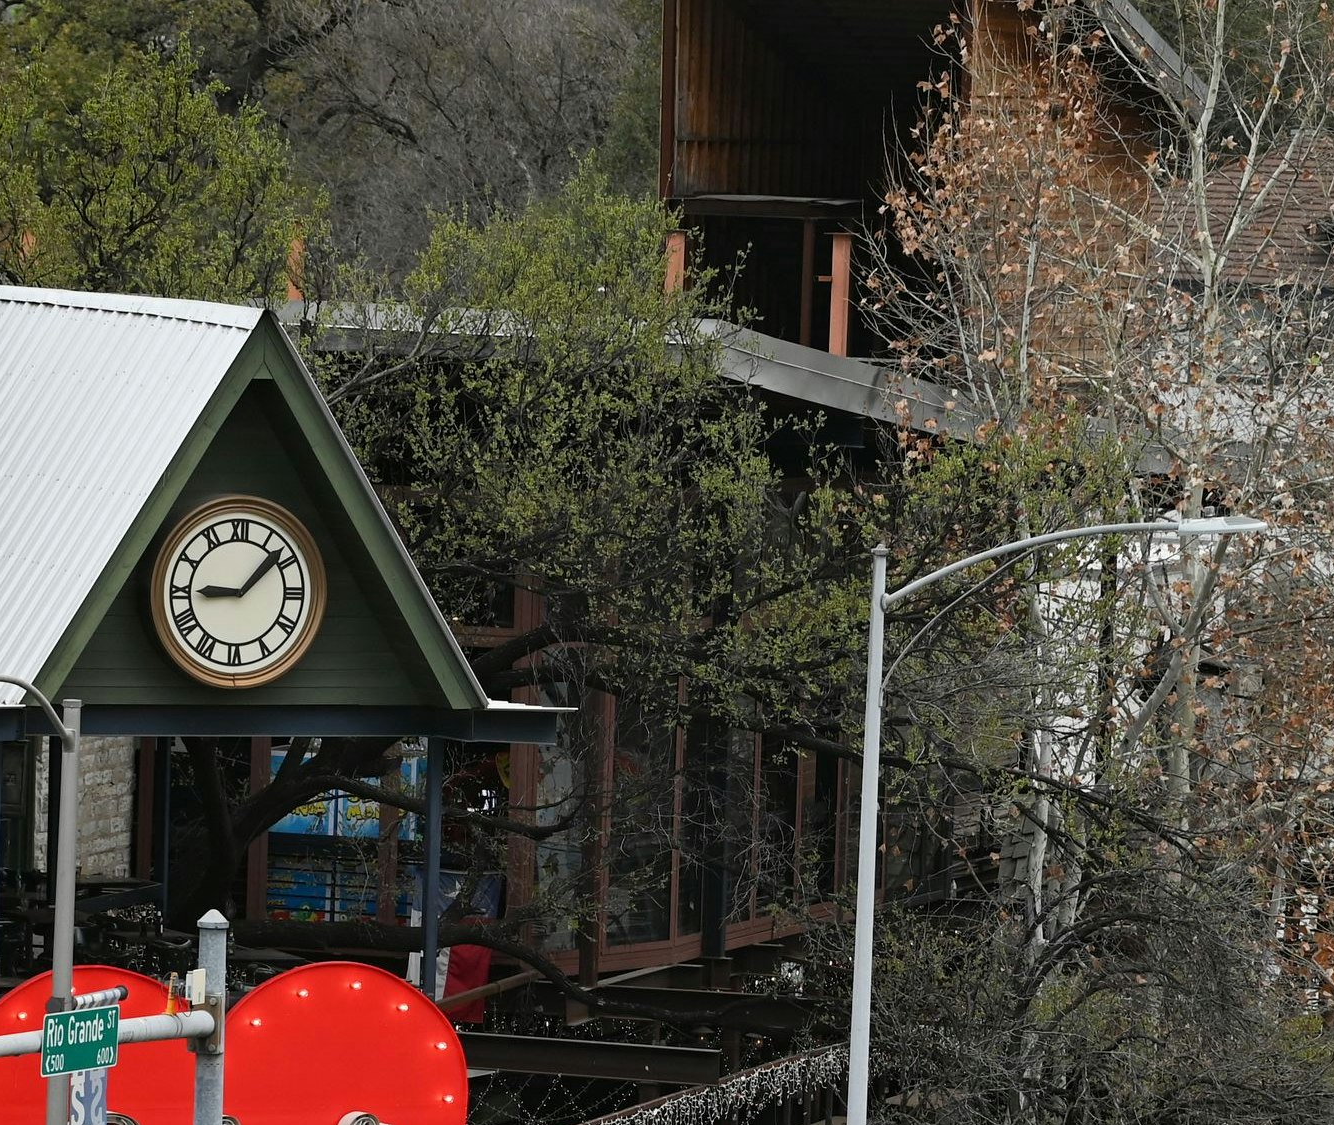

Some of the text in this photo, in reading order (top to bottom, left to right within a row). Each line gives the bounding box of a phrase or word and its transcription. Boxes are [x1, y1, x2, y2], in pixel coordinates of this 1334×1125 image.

[47, 1009, 117, 1048] Rio Grande ST
[51, 1054, 64, 1071] 500
[97, 1048, 110, 1066] 600
